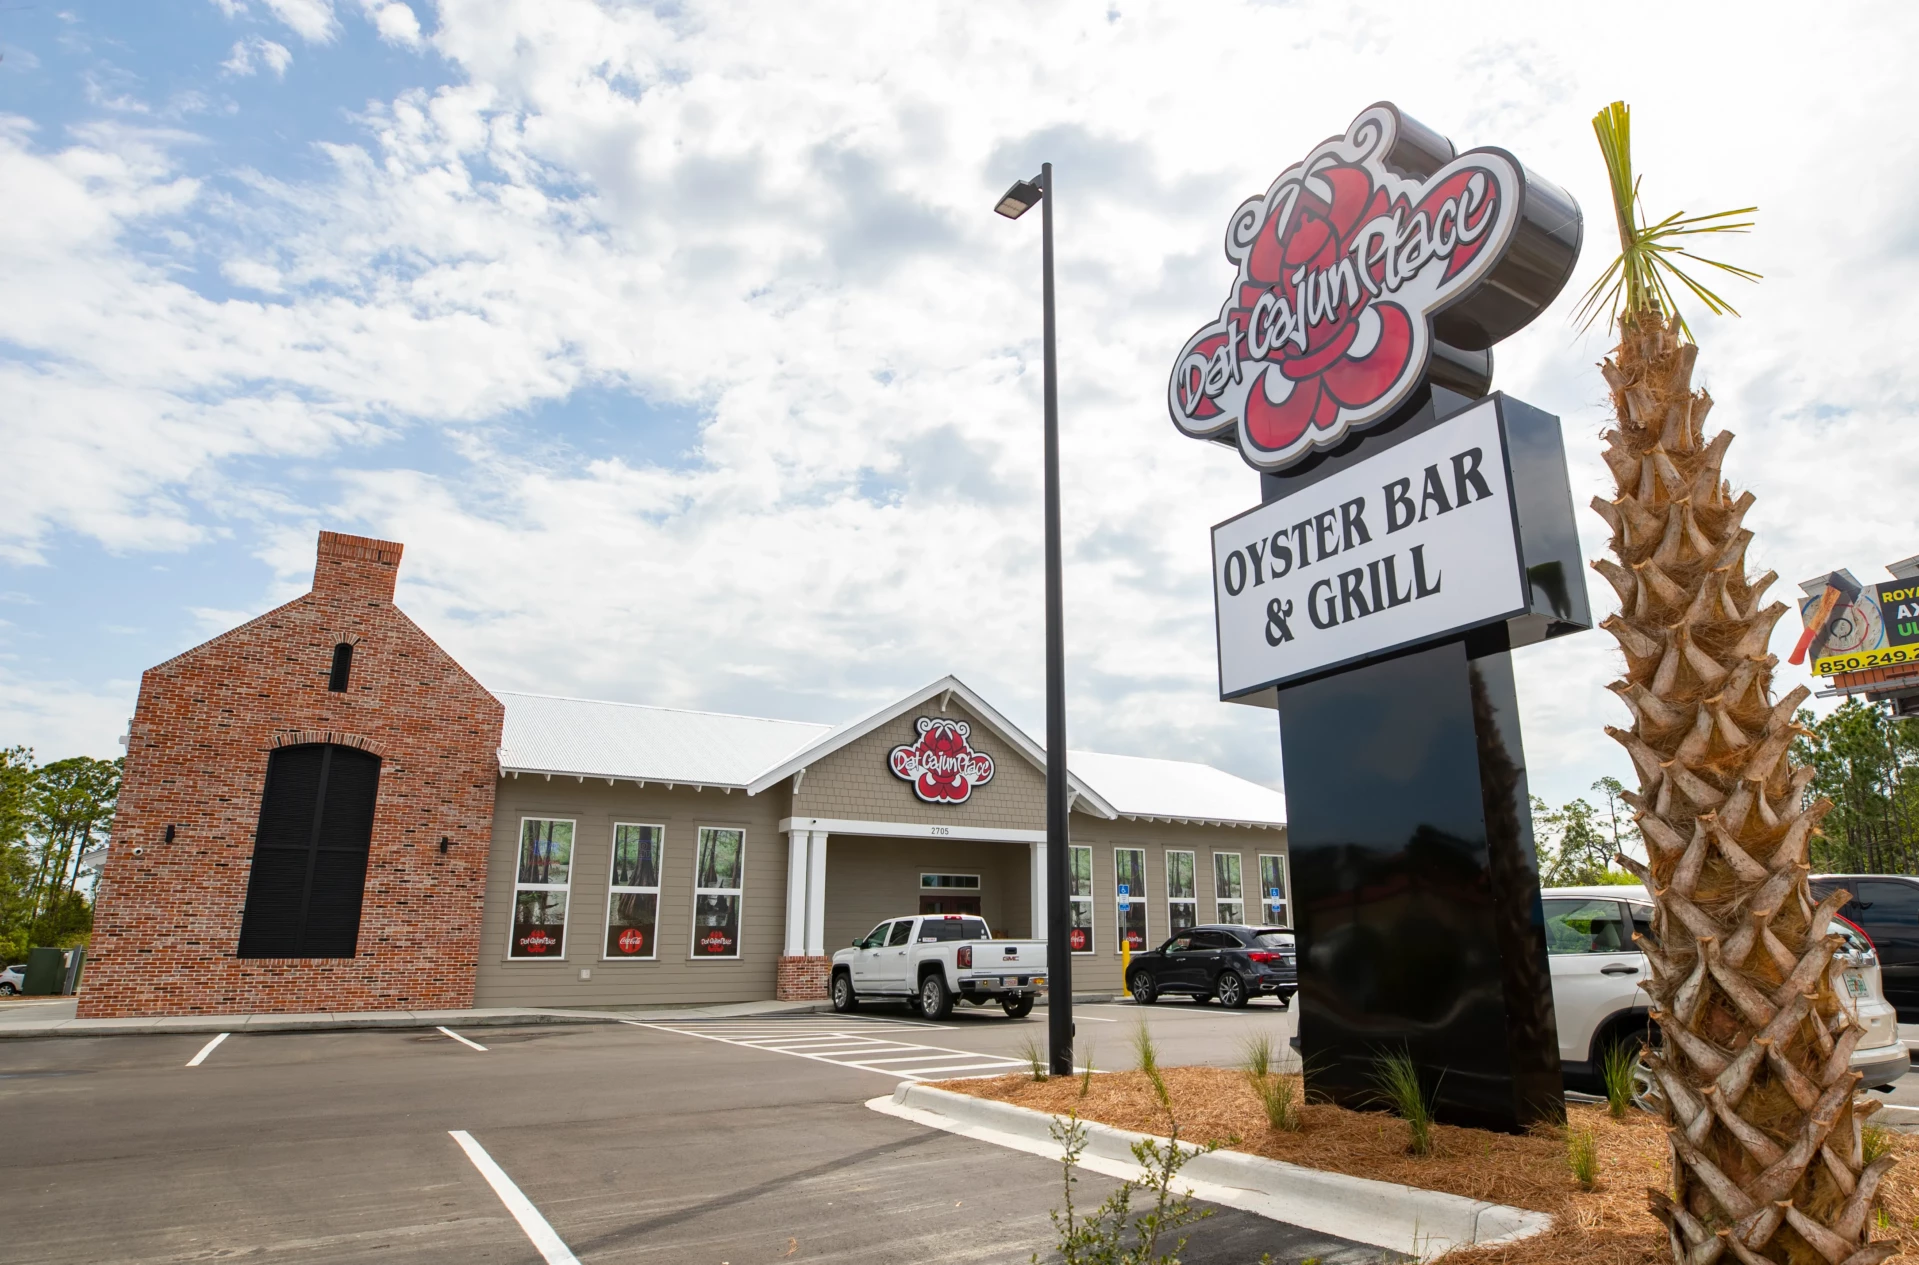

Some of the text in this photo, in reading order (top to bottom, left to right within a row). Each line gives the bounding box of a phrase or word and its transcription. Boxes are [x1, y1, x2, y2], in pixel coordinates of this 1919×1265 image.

[1179, 172, 1496, 417] Dat Cajun Place
[1223, 447, 1494, 597] OYSTER BAR
[1264, 543, 1442, 647] & GRILL
[1881, 586, 1919, 603] ROY
[895, 750, 991, 776] Dat Cajun Place
[931, 827, 949, 835] 2705
